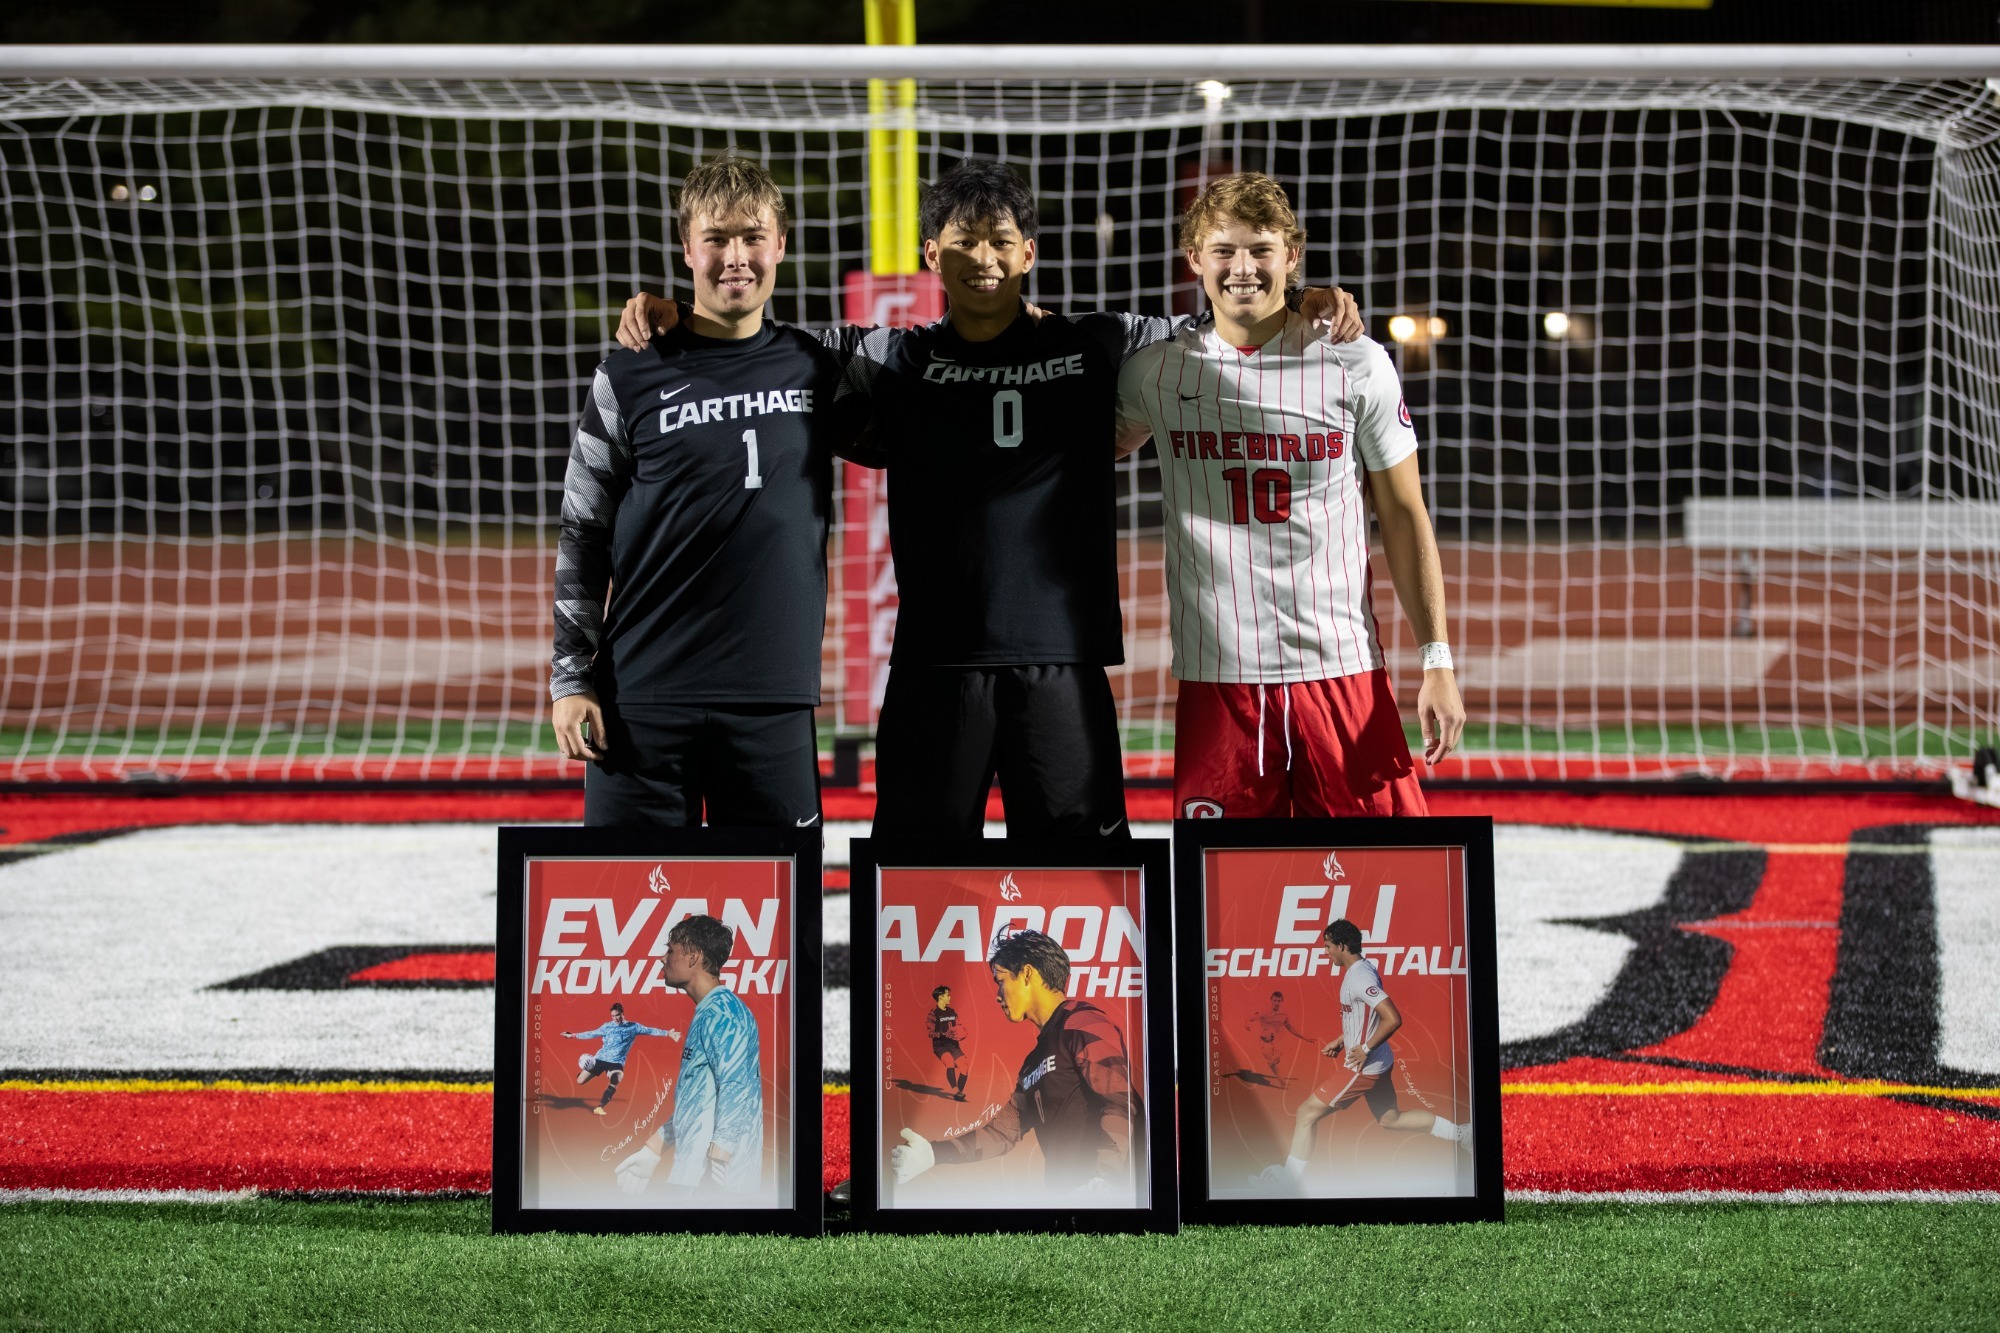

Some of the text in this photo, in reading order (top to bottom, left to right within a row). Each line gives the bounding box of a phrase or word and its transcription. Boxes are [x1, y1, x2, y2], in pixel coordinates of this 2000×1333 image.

[922, 353, 1085, 385] CARTHAGE
[659, 389, 814, 434] CARTHAGE
[992, 389, 1024, 448] 0
[742, 429, 763, 489] 1
[1169, 430, 1344, 462] FIREBIRDS
[1222, 467, 1292, 525] 10
[538, 898, 781, 957] EVAN
[1274, 884, 1397, 944] ELI
[531, 959, 789, 995] KOWASKI
[1066, 966, 1143, 998] THE
[884, 983, 892, 1017] 2026
[1211, 985, 1219, 1021] 2026
[885, 1024, 892, 1040] OF
[1212, 1028, 1219, 1045] OF
[533, 1004, 542, 1115] CLASS OF 2026
[943, 1119, 983, 1138] Aaron
